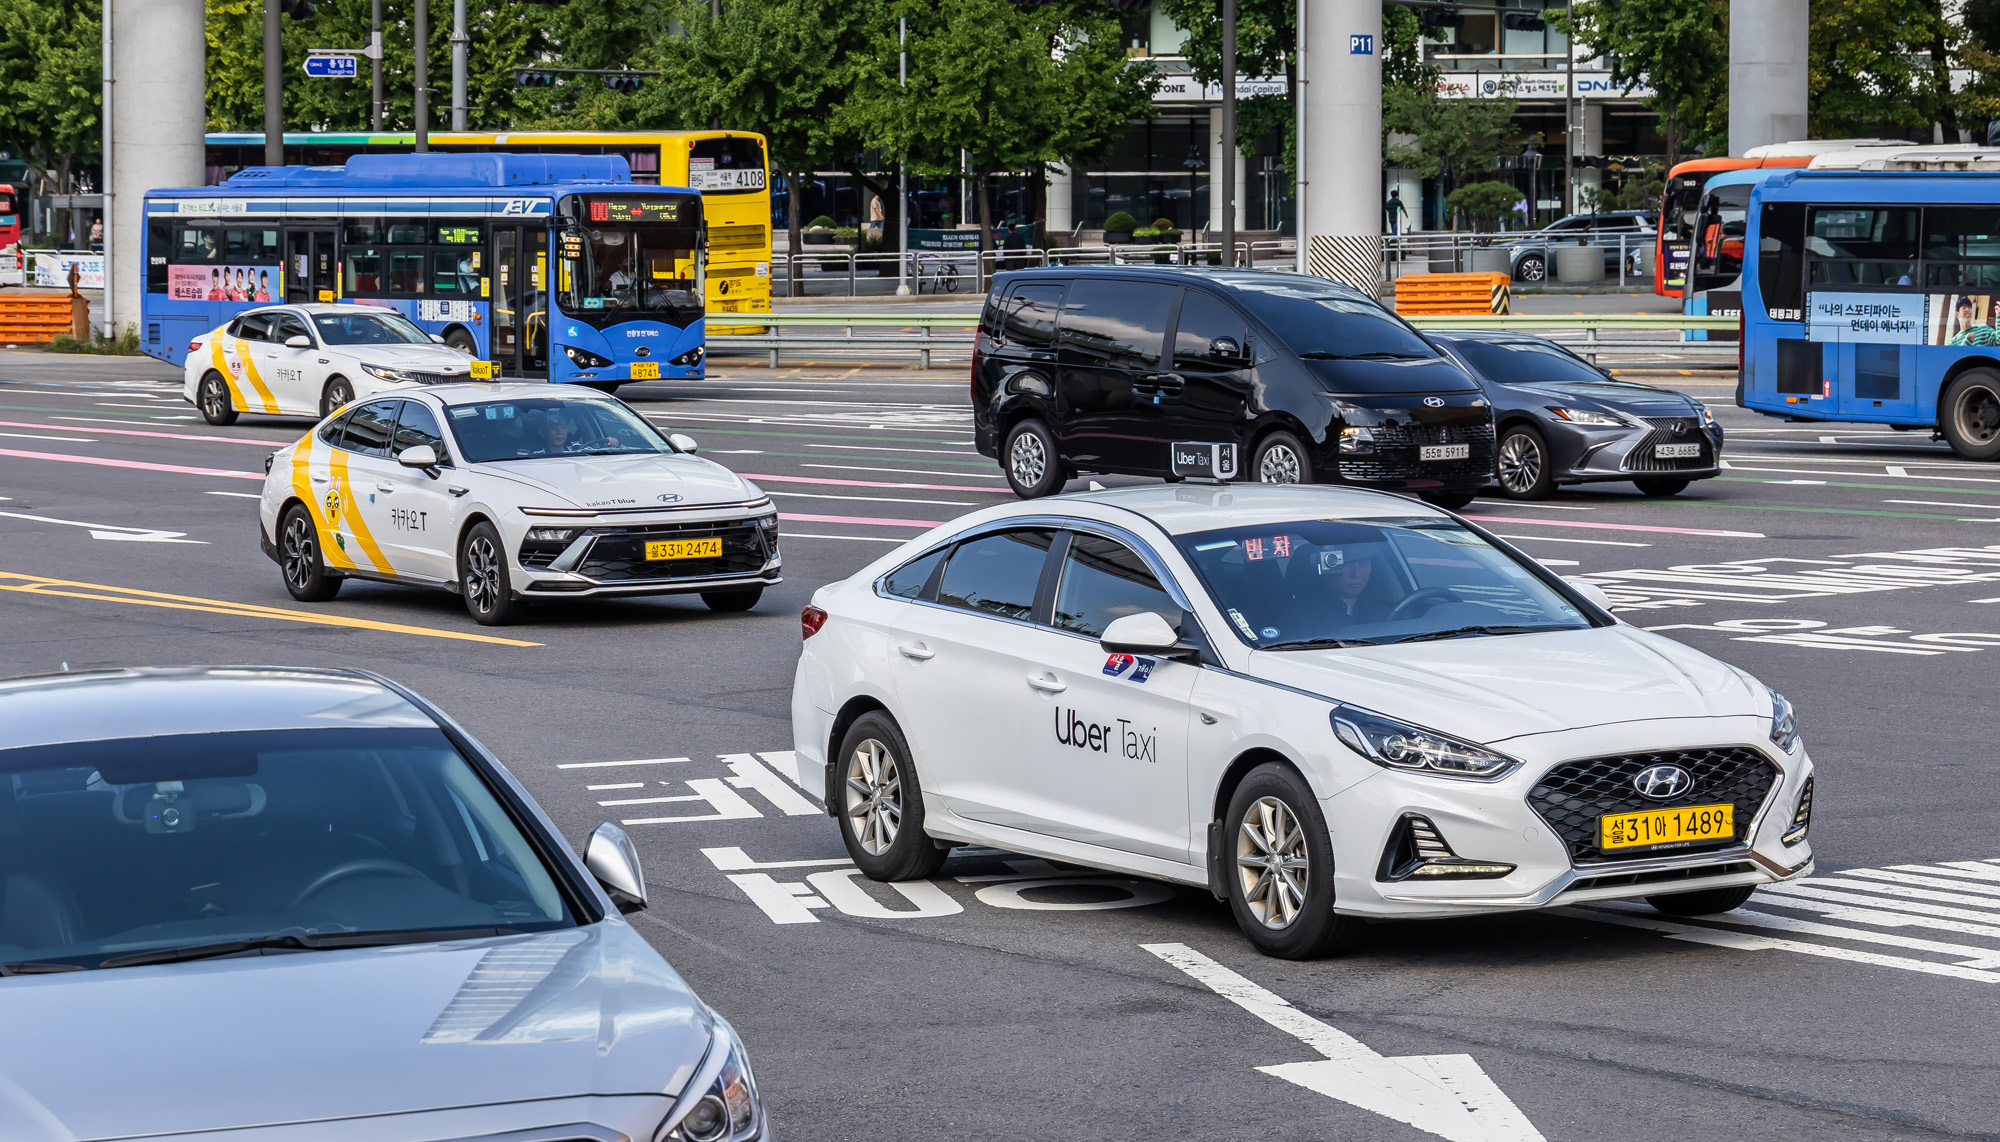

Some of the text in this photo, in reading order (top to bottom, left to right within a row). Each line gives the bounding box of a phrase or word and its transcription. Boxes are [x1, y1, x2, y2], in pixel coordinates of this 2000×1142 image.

[1351, 37, 1371, 52] P11
[329, 59, 354, 69] 통일로
[1252, 85, 1282, 94] Capital
[1577, 81, 1607, 91] DN
[736, 170, 764, 186] 4108
[509, 200, 532, 214] EV
[1769, 308, 1801, 320] 태릉교통
[1845, 304, 1901, 317] 스포티파이는
[1851, 319, 1879, 332] 먼데이
[1445, 447, 1465, 457] 5911
[1678, 445, 1697, 456] 6685
[1176, 451, 1210, 466] Uber Taxi
[1222, 447, 1231, 471] 서울
[686, 541, 718, 556] 2474
[1055, 706, 1156, 763] Uber Taxi
[1673, 809, 1724, 837] 1489
